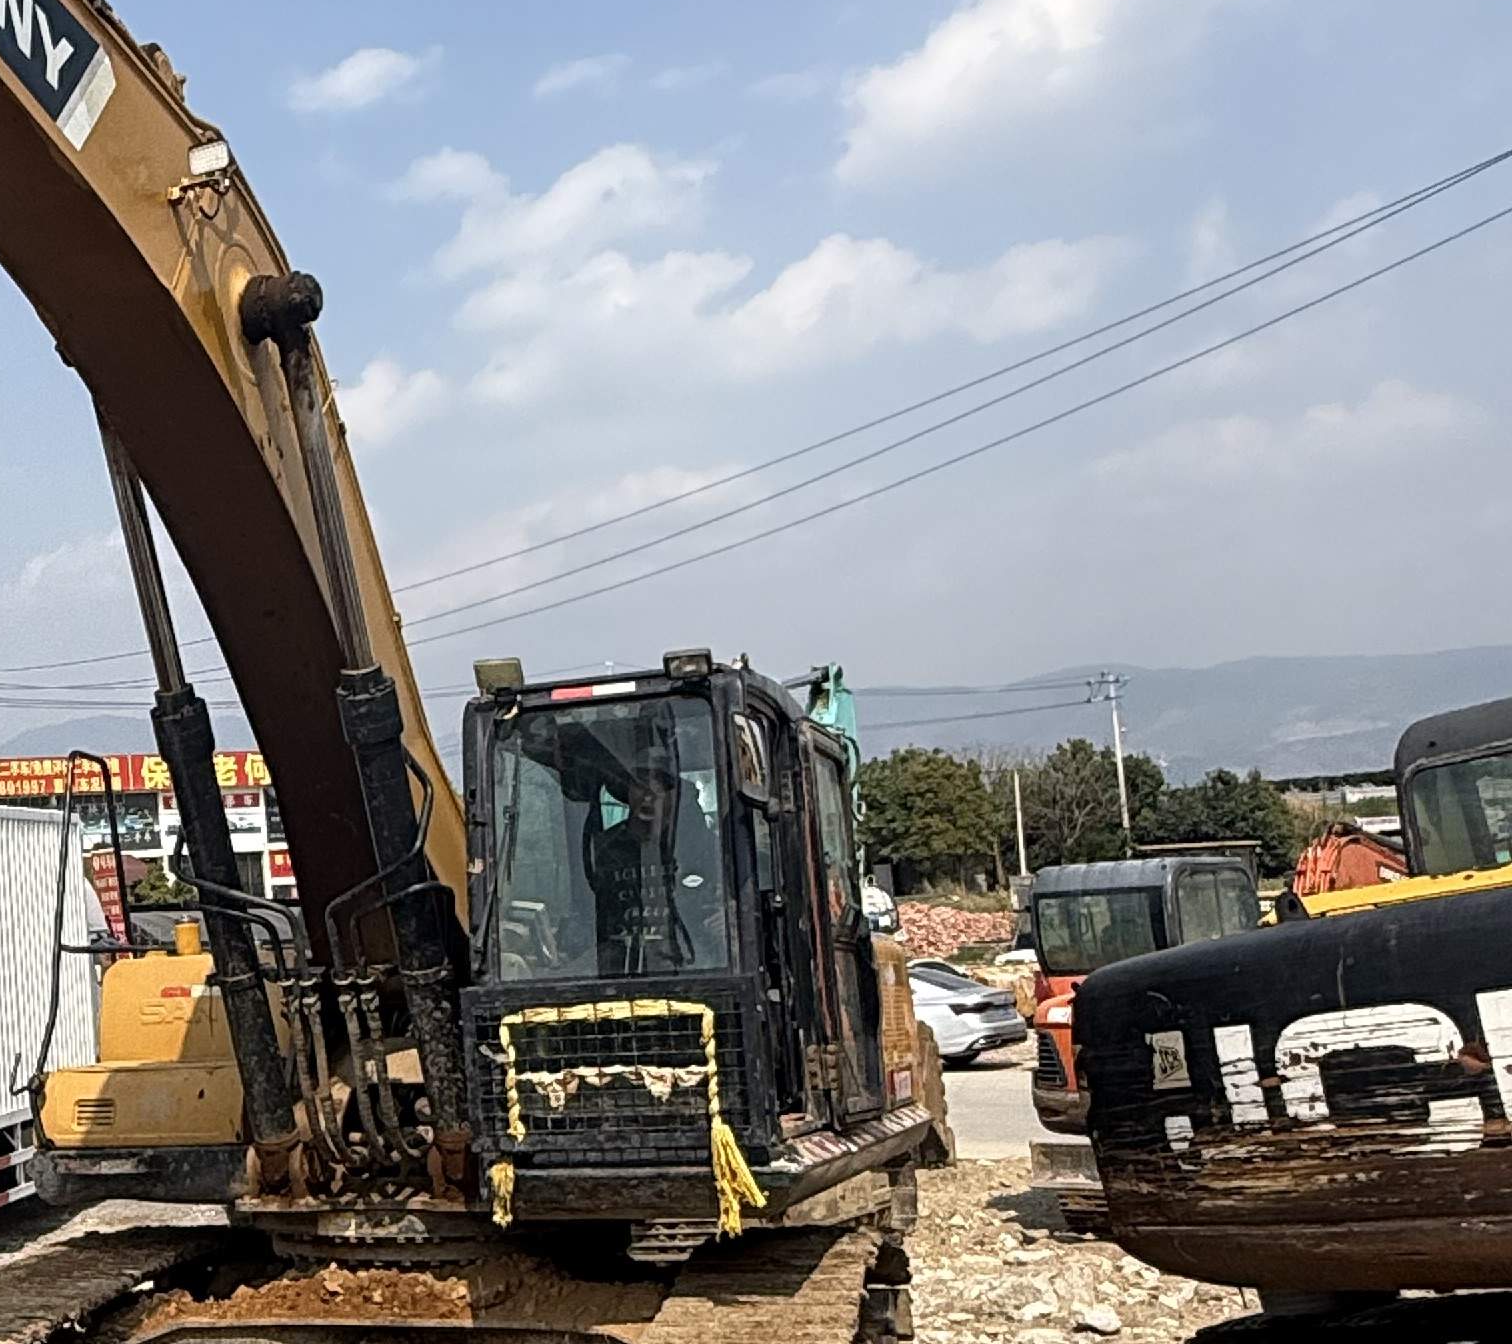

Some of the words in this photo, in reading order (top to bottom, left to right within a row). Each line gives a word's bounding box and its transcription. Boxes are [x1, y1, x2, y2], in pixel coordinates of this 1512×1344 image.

[141, 752, 273, 791] 保老何
[1157, 1047, 1184, 1074] JCB
